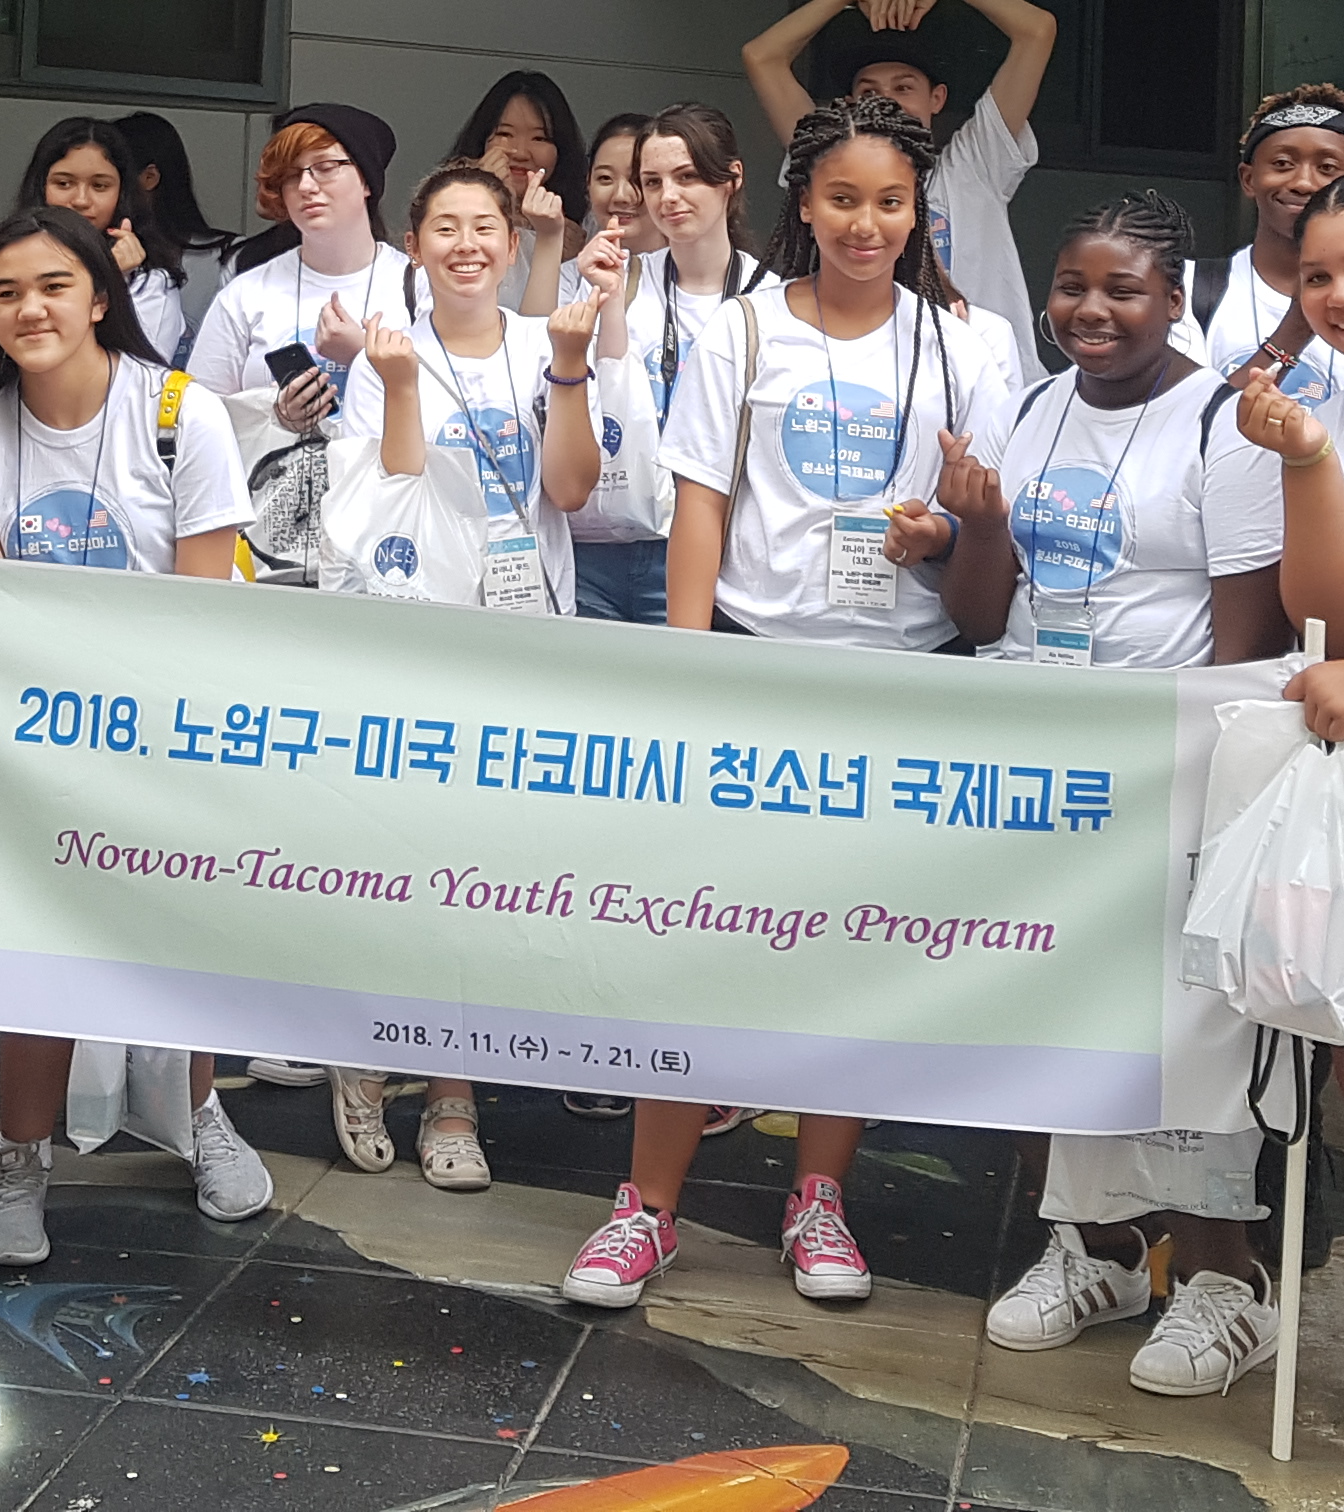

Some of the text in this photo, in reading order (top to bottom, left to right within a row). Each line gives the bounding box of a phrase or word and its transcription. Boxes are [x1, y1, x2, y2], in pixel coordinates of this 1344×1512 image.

[791, 419, 831, 433] 노원구
[829, 448, 860, 462] 2018
[802, 462, 885, 480] 청소년 국제교류
[1066, 514, 1115, 535] 타코마시
[68, 536, 118, 552] 타코마시
[1054, 540, 1080, 553] 2018
[377, 549, 415, 563] NCS
[1036, 549, 1062, 565] 청소년
[14, 687, 1113, 833] 2018. 노원구-미국 타코마시 청소년 국제교류
[55, 830, 1056, 960] Nowon-Tacoma Youth Exchange Program
[373, 1021, 432, 1047] 2018.
[441, 1029, 459, 1049] 7.
[470, 1032, 500, 1053] 11.
[509, 1034, 549, 1061] (수)
[580, 1043, 599, 1064] 7.
[608, 1047, 641, 1069] 21.
[651, 1049, 691, 1075] (토)
